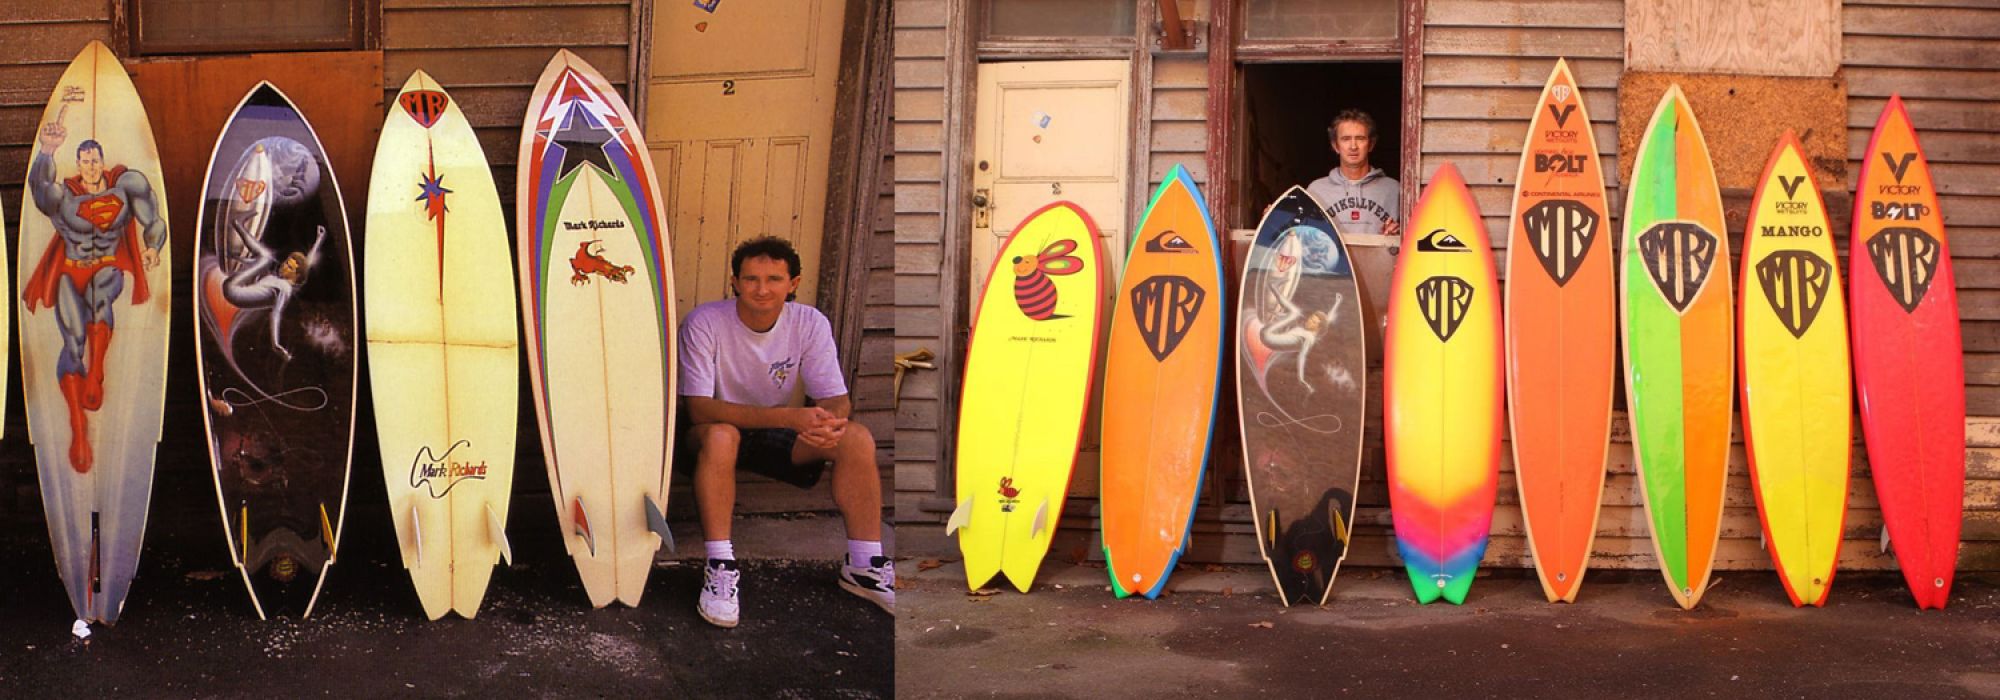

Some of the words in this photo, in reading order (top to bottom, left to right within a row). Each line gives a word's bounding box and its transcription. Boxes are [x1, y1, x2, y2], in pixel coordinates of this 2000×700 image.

[723, 80, 735, 95] 2
[399, 90, 449, 128] MR
[1545, 130, 1577, 138] VICTORY
[1535, 153, 1587, 173] BOLT
[1880, 184, 1921, 196] VICTORY
[1326, 196, 1391, 221] UIKSILVER
[1776, 201, 1807, 209] VICTORY
[1522, 199, 1600, 288] MR
[1761, 226, 1823, 237] MANGO
[1639, 223, 1717, 313] MR
[1866, 227, 1940, 314] MR
[1755, 250, 1832, 340] MR
[1130, 275, 1206, 362] MR
[1415, 276, 1475, 343] MR
[420, 463, 447, 478] Mark
[449, 461, 487, 477] Richards
